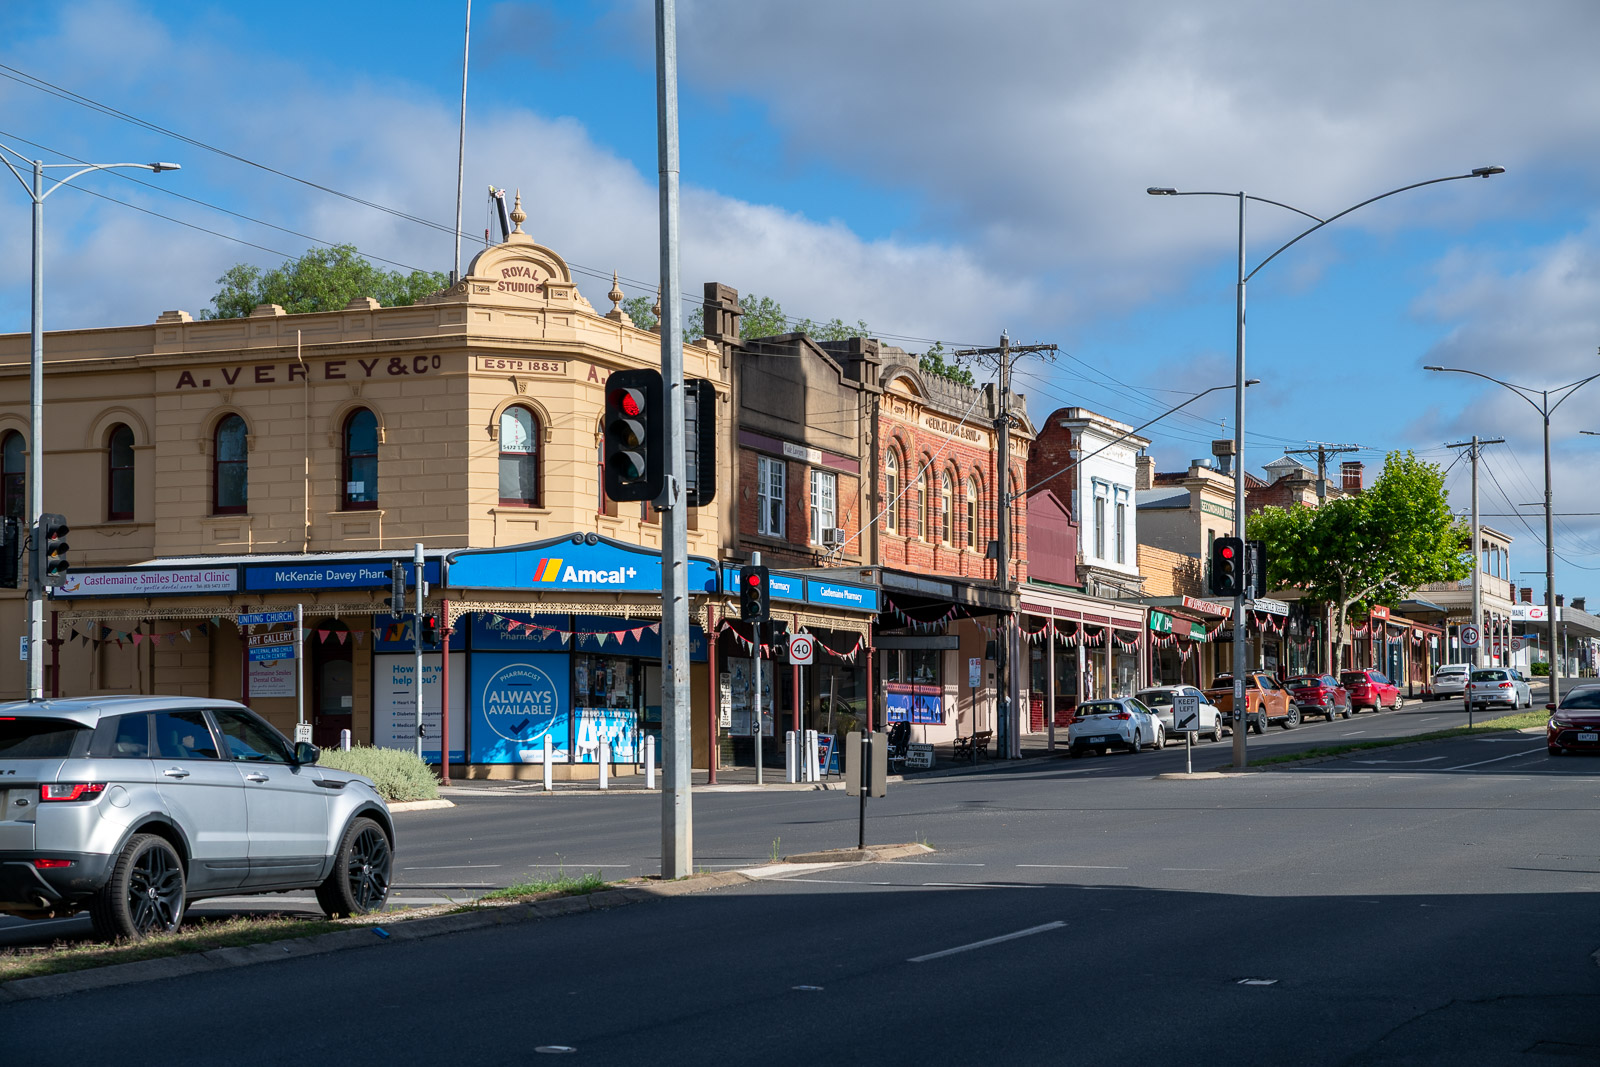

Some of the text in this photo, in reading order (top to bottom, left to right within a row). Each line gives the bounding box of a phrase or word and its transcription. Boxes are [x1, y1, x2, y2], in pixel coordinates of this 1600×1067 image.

[501, 266, 539, 282] ROYAL
[498, 281, 543, 293] STUDIOS
[484, 359, 559, 372] ESTD 1883
[84, 571, 230, 586] Castlemaine Smiles Dental Clinic
[275, 571, 323, 582] McKenzie
[326, 569, 356, 582] Davey
[769, 578, 790, 594] Pharmacy
[820, 586, 863, 603] Castlemaine Pharmacy
[238, 612, 292, 624] UNITING CHURCH
[248, 632, 292, 646] ART GALLERY
[1464, 632, 1476, 640] 40
[794, 644, 808, 655] 40
[392, 665, 414, 674] How
[392, 675, 437, 686] help ou?
[500, 670, 541, 682] PHARMACIST
[489, 691, 552, 703] ALWAYS
[489, 705, 552, 715] AVAILABLE
